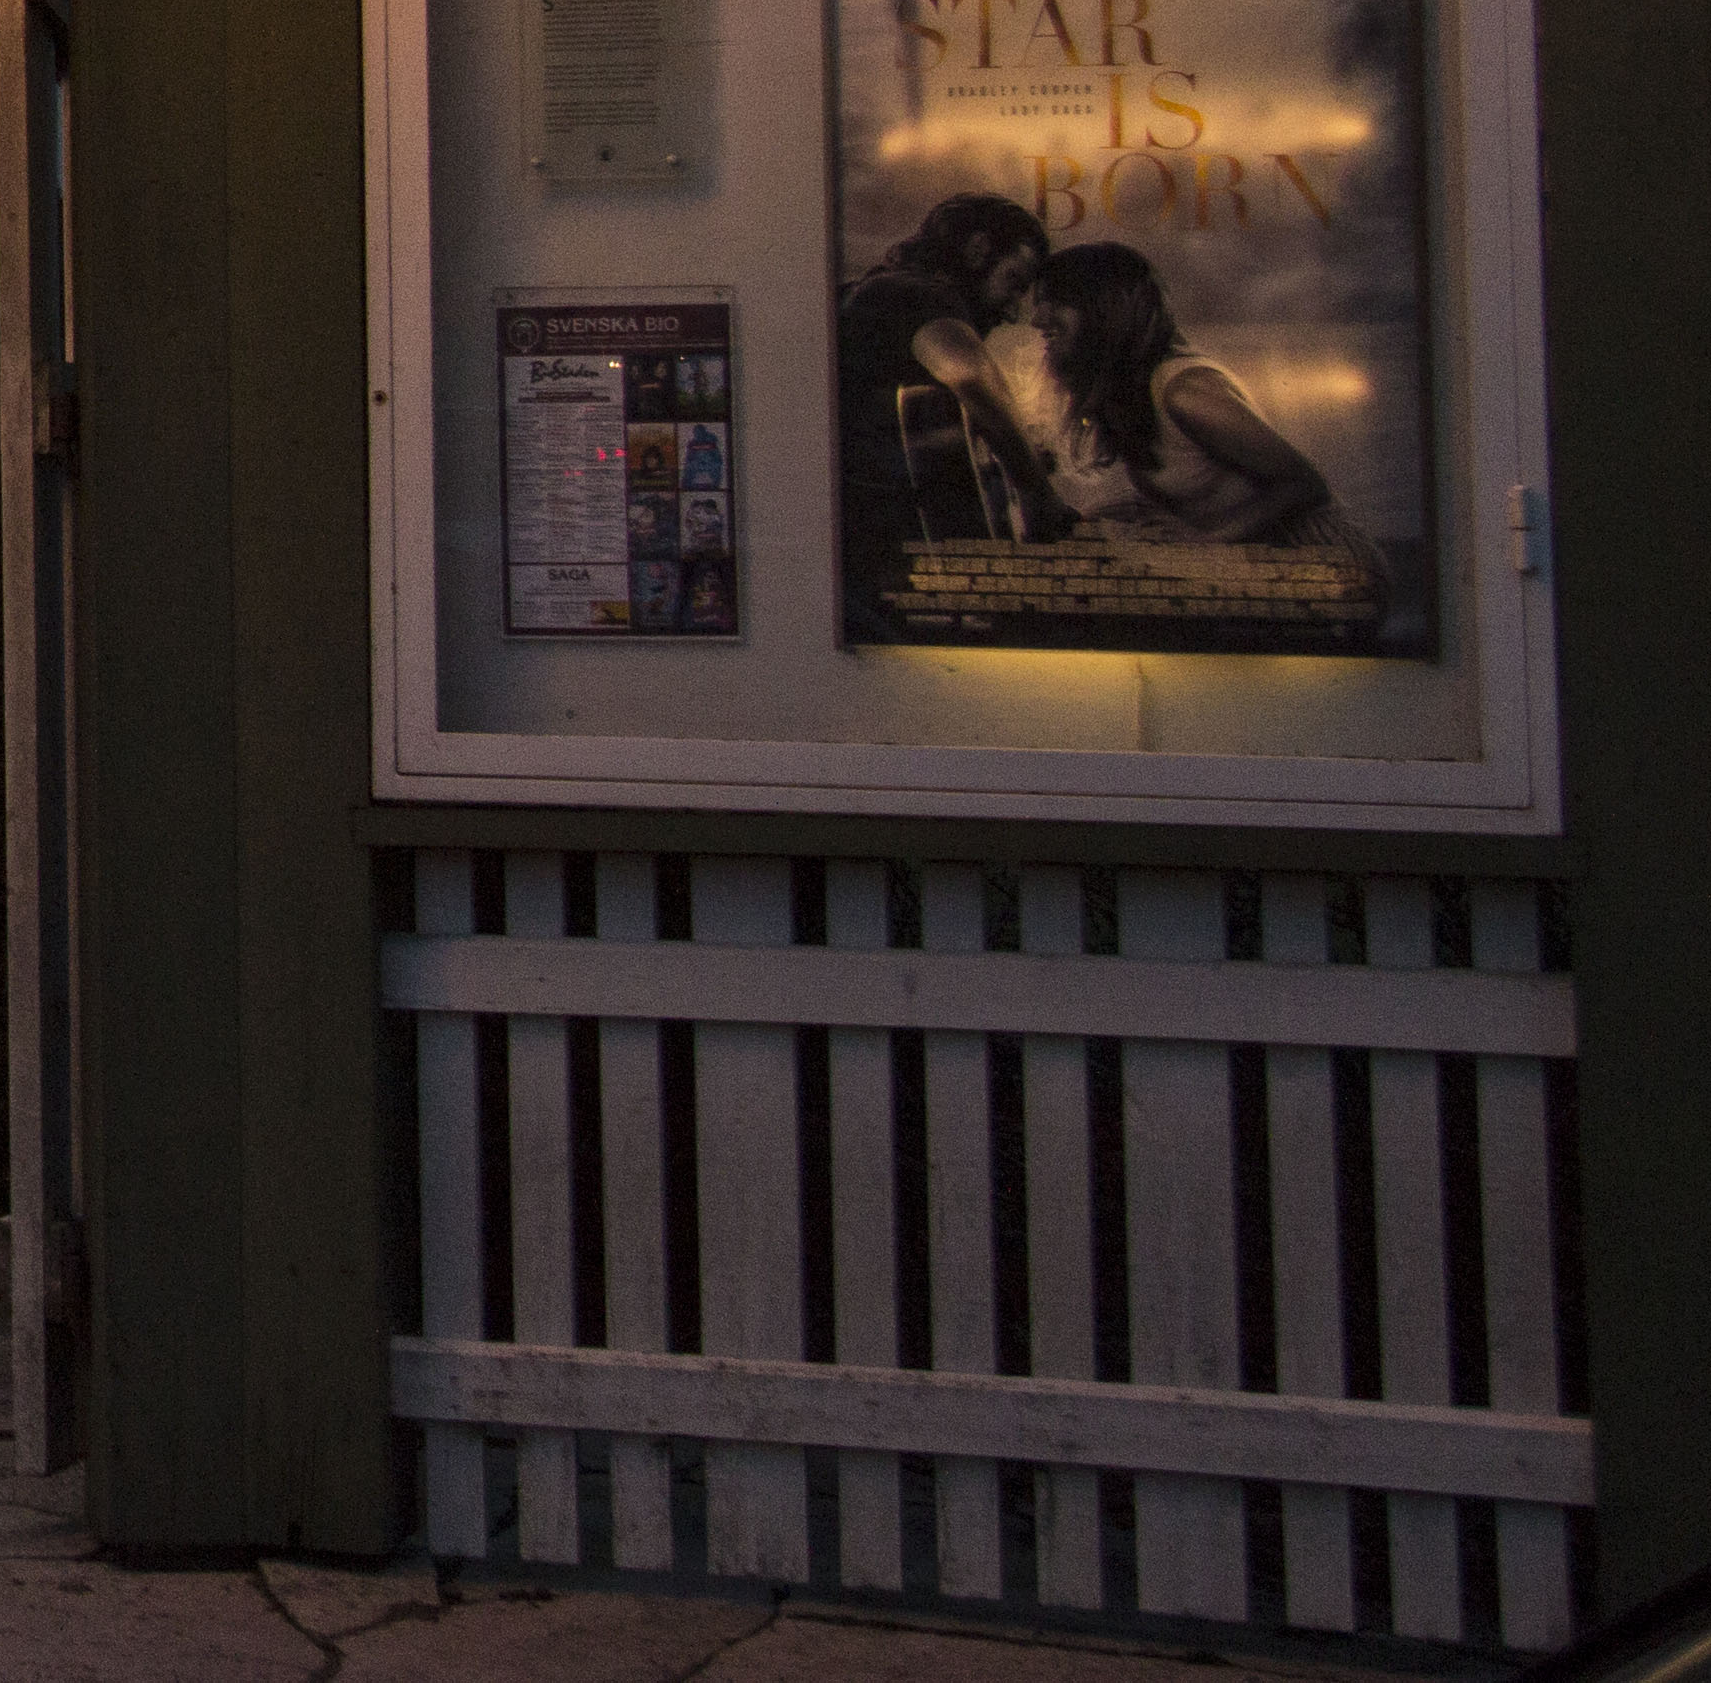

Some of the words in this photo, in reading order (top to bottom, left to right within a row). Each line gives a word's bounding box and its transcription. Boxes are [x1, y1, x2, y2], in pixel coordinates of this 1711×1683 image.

[1097, 71, 1207, 151] IS
[1024, 152, 1338, 232] BORN
[546, 317, 639, 333] SVENSKA
[645, 316, 680, 332] BIO
[548, 568, 591, 582] SAGA
